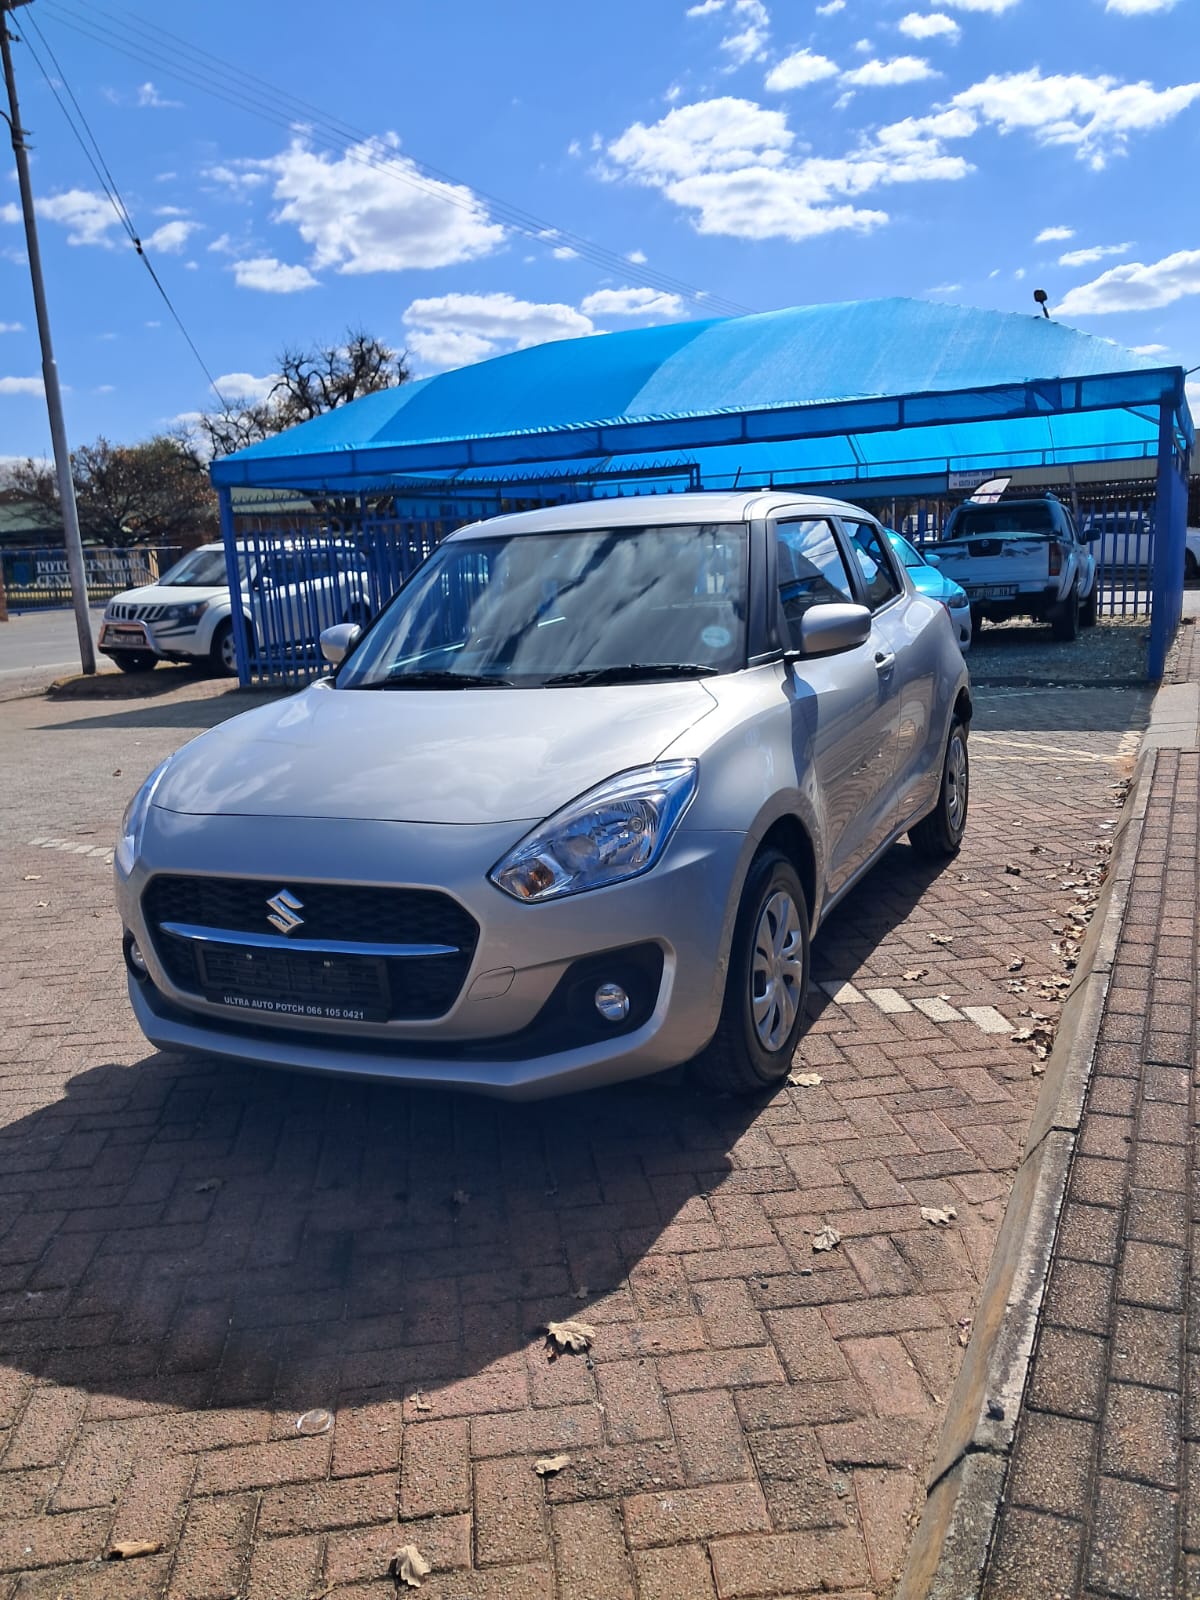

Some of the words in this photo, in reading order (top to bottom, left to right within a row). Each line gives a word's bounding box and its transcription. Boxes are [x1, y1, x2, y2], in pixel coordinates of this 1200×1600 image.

[37, 573, 97, 588] CENTL
[224, 996, 250, 1007] ULTRA
[251, 999, 274, 1010] AUTO
[275, 1002, 304, 1013] POTCH
[306, 1006, 322, 1015] 066
[325, 1008, 341, 1017] 105
[343, 1009, 364, 1019] 0421
